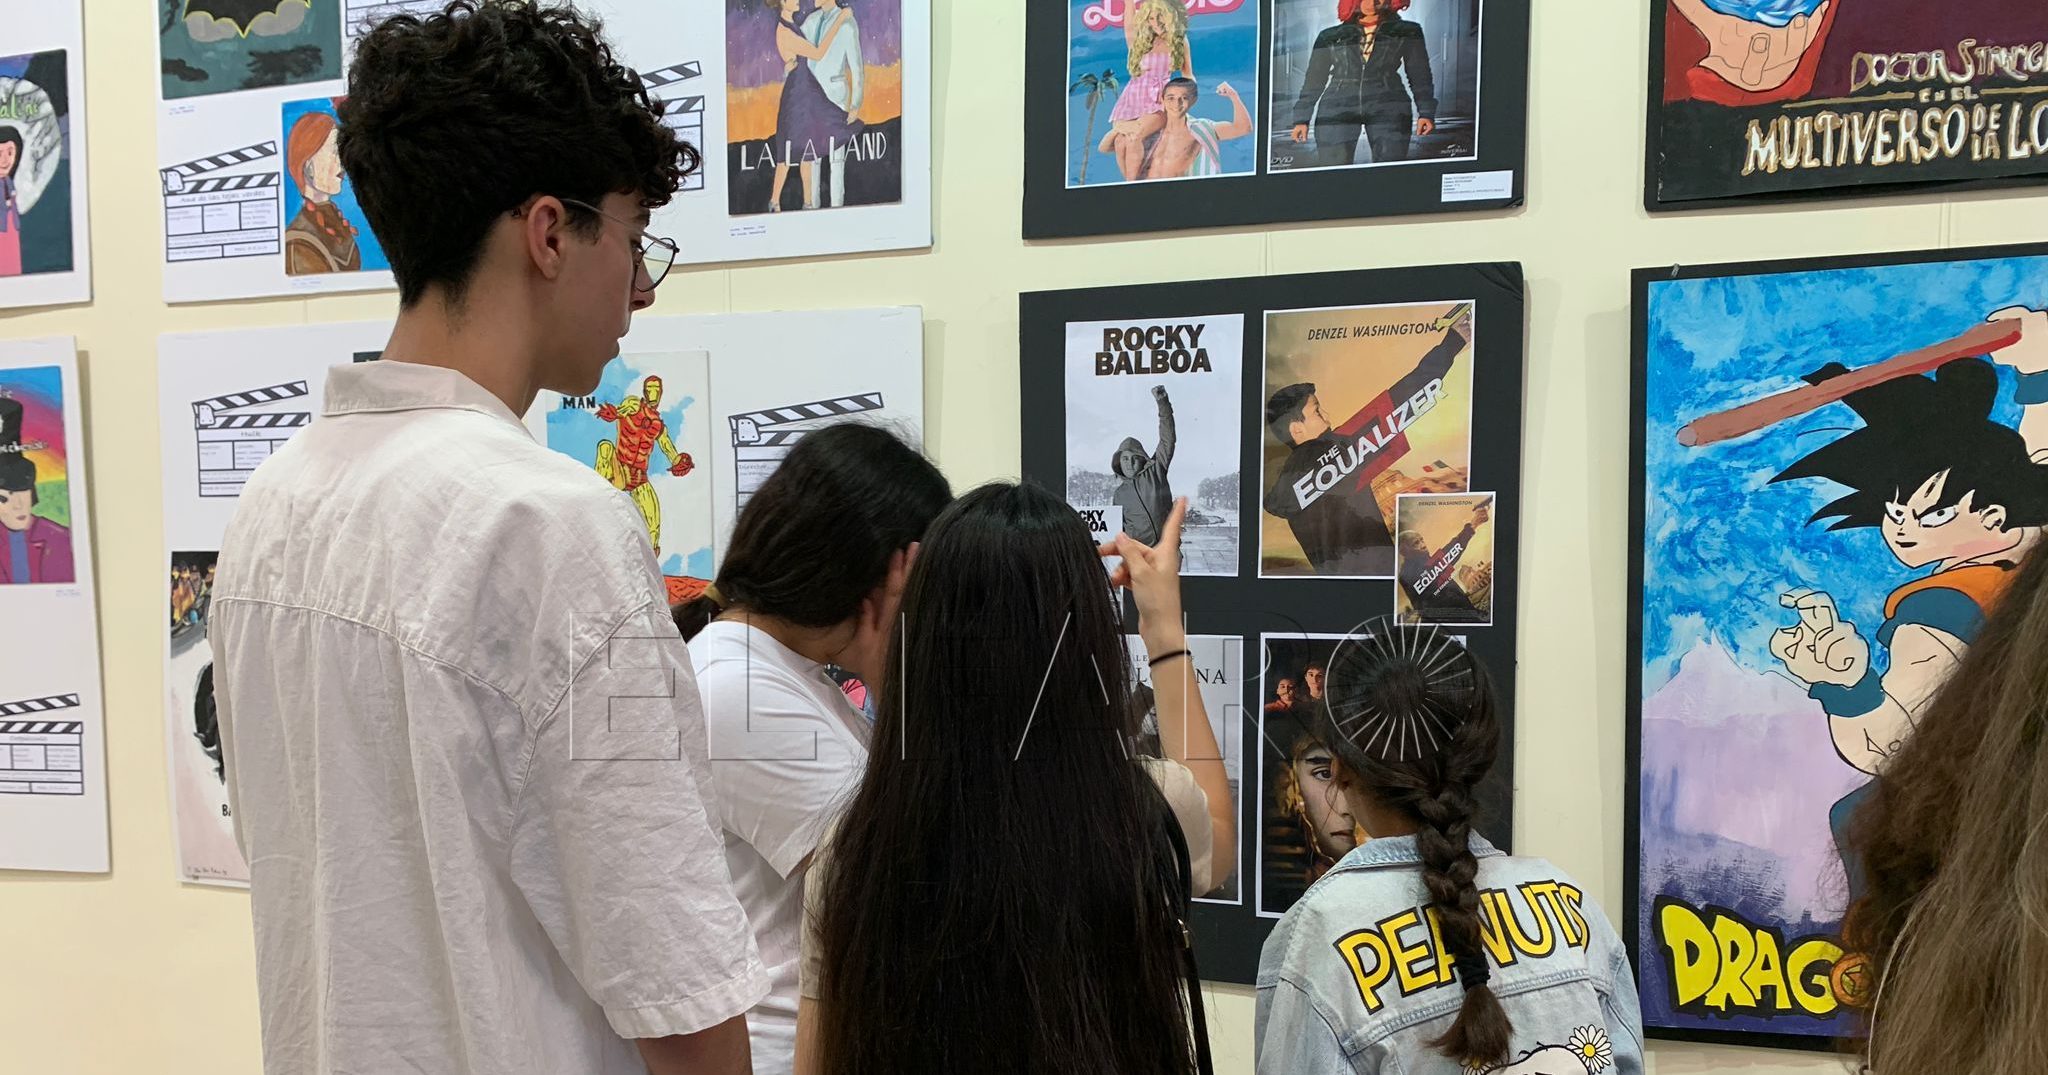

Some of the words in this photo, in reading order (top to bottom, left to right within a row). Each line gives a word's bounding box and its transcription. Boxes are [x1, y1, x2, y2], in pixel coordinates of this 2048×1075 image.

[1850, 50, 1951, 92] DOCTOR
[1951, 86, 1979, 101] EL
[1972, 102, 2002, 132] DE
[2008, 100, 2048, 159] LO
[741, 143, 777, 171] LA
[785, 139, 822, 167] LA
[830, 132, 888, 163] LAND
[1741, 102, 1970, 176] MULTIVERSO
[1971, 130, 2000, 161] LA
[1103, 323, 1206, 352] ROCKY
[1308, 327, 1348, 341] DENZEL
[1353, 322, 1437, 338] WASHINGTON
[1095, 347, 1212, 376] BALBOA
[562, 396, 596, 410] MAN
[1292, 378, 1449, 511] EQUALIZER
[1316, 444, 1340, 466] THE
[1079, 509, 1105, 522] CKY
[1413, 542, 1464, 596] EQUALIZER
[1655, 897, 1874, 1018] DRAGO
